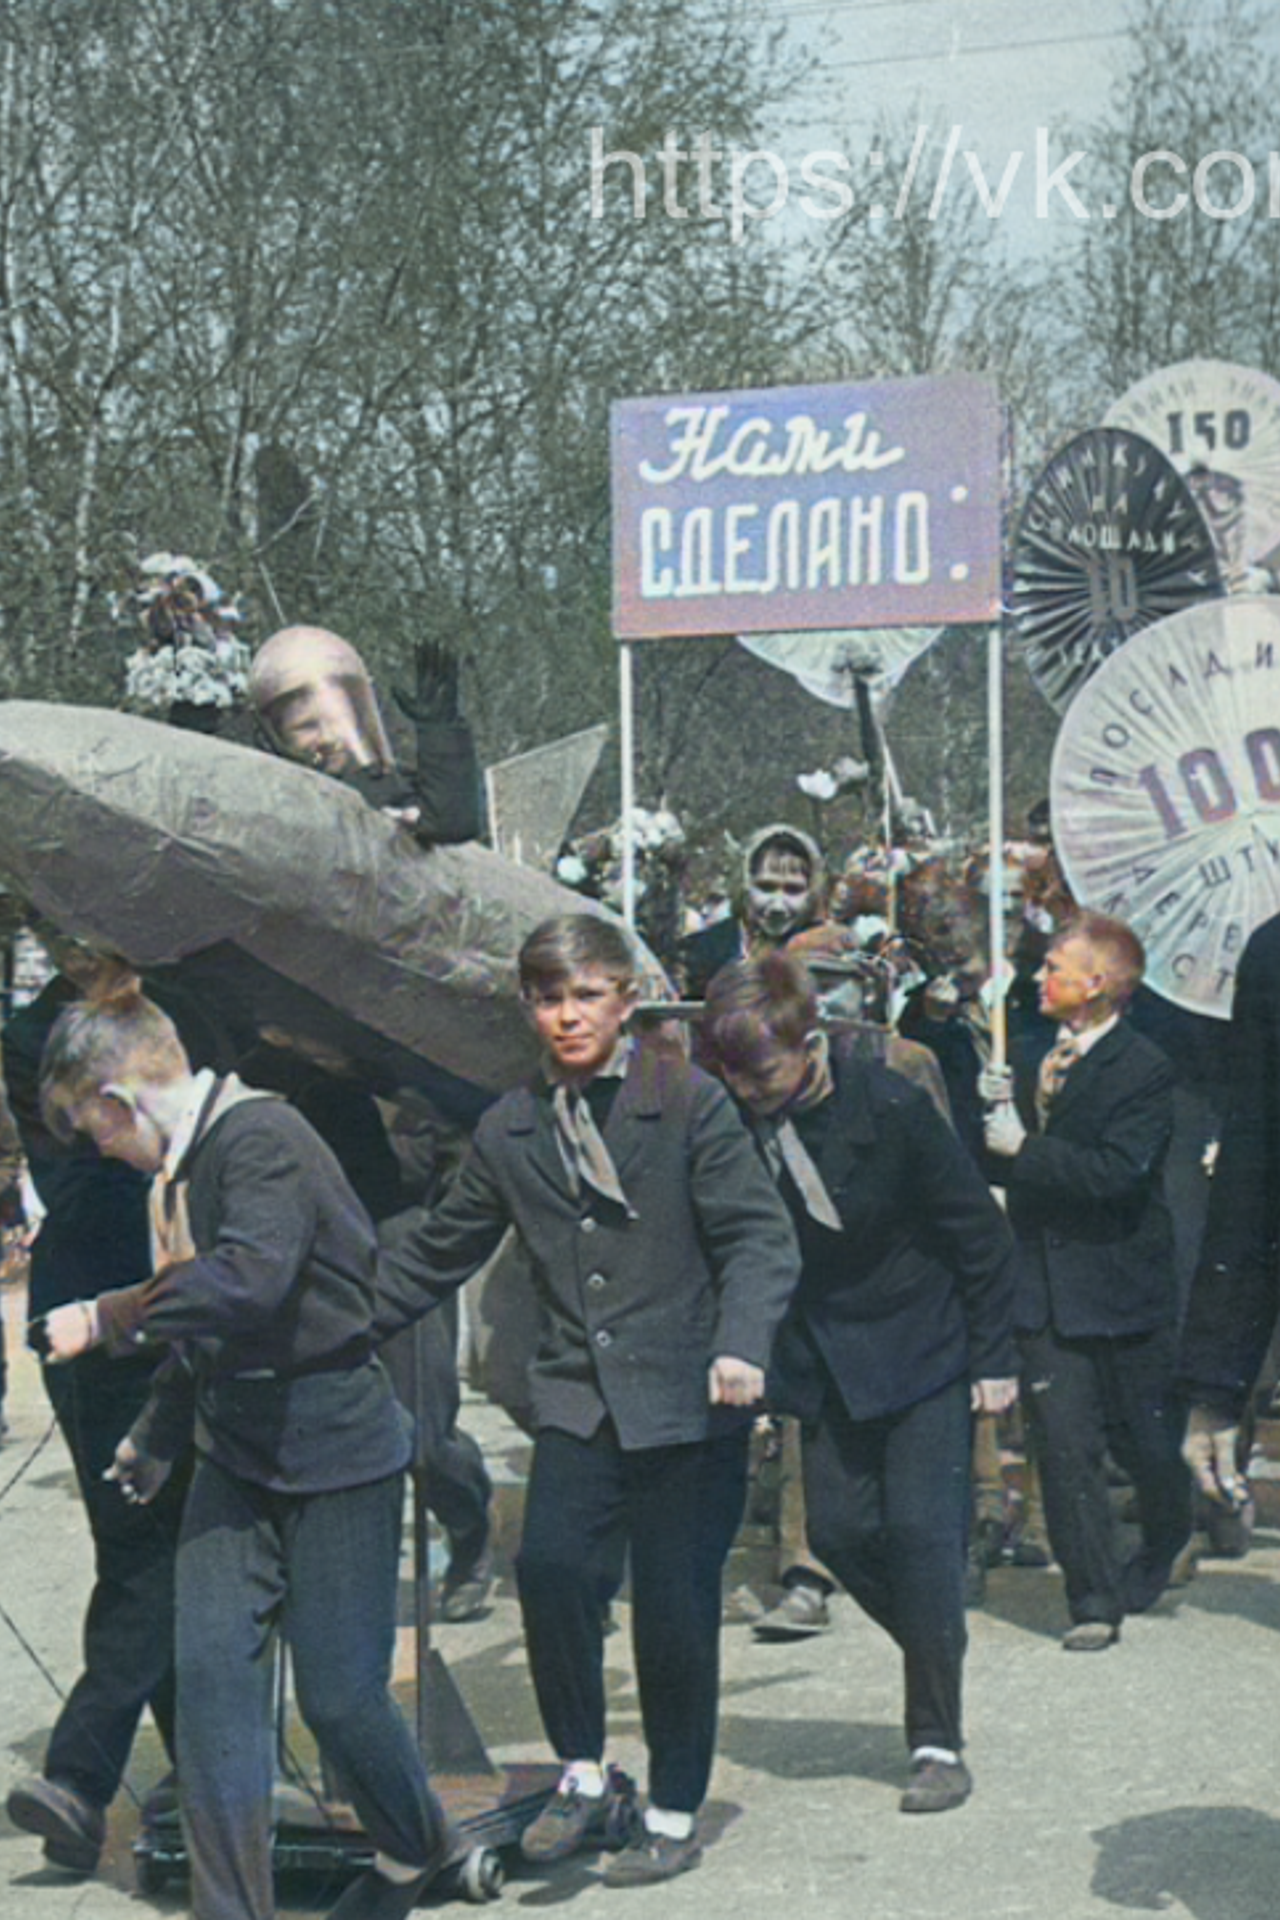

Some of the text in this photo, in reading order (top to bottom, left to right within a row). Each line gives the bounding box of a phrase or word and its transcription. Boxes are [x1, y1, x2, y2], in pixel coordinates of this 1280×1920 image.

[639, 404, 905, 483] Нами
[1166, 408, 1251, 454] 150
[1089, 641, 1273, 788] ПОСАДИ
[1138, 725, 1280, 841] 100
[1199, 838, 1280, 888] ШТУ
[1131, 863, 1242, 954] ДЕРЕ
